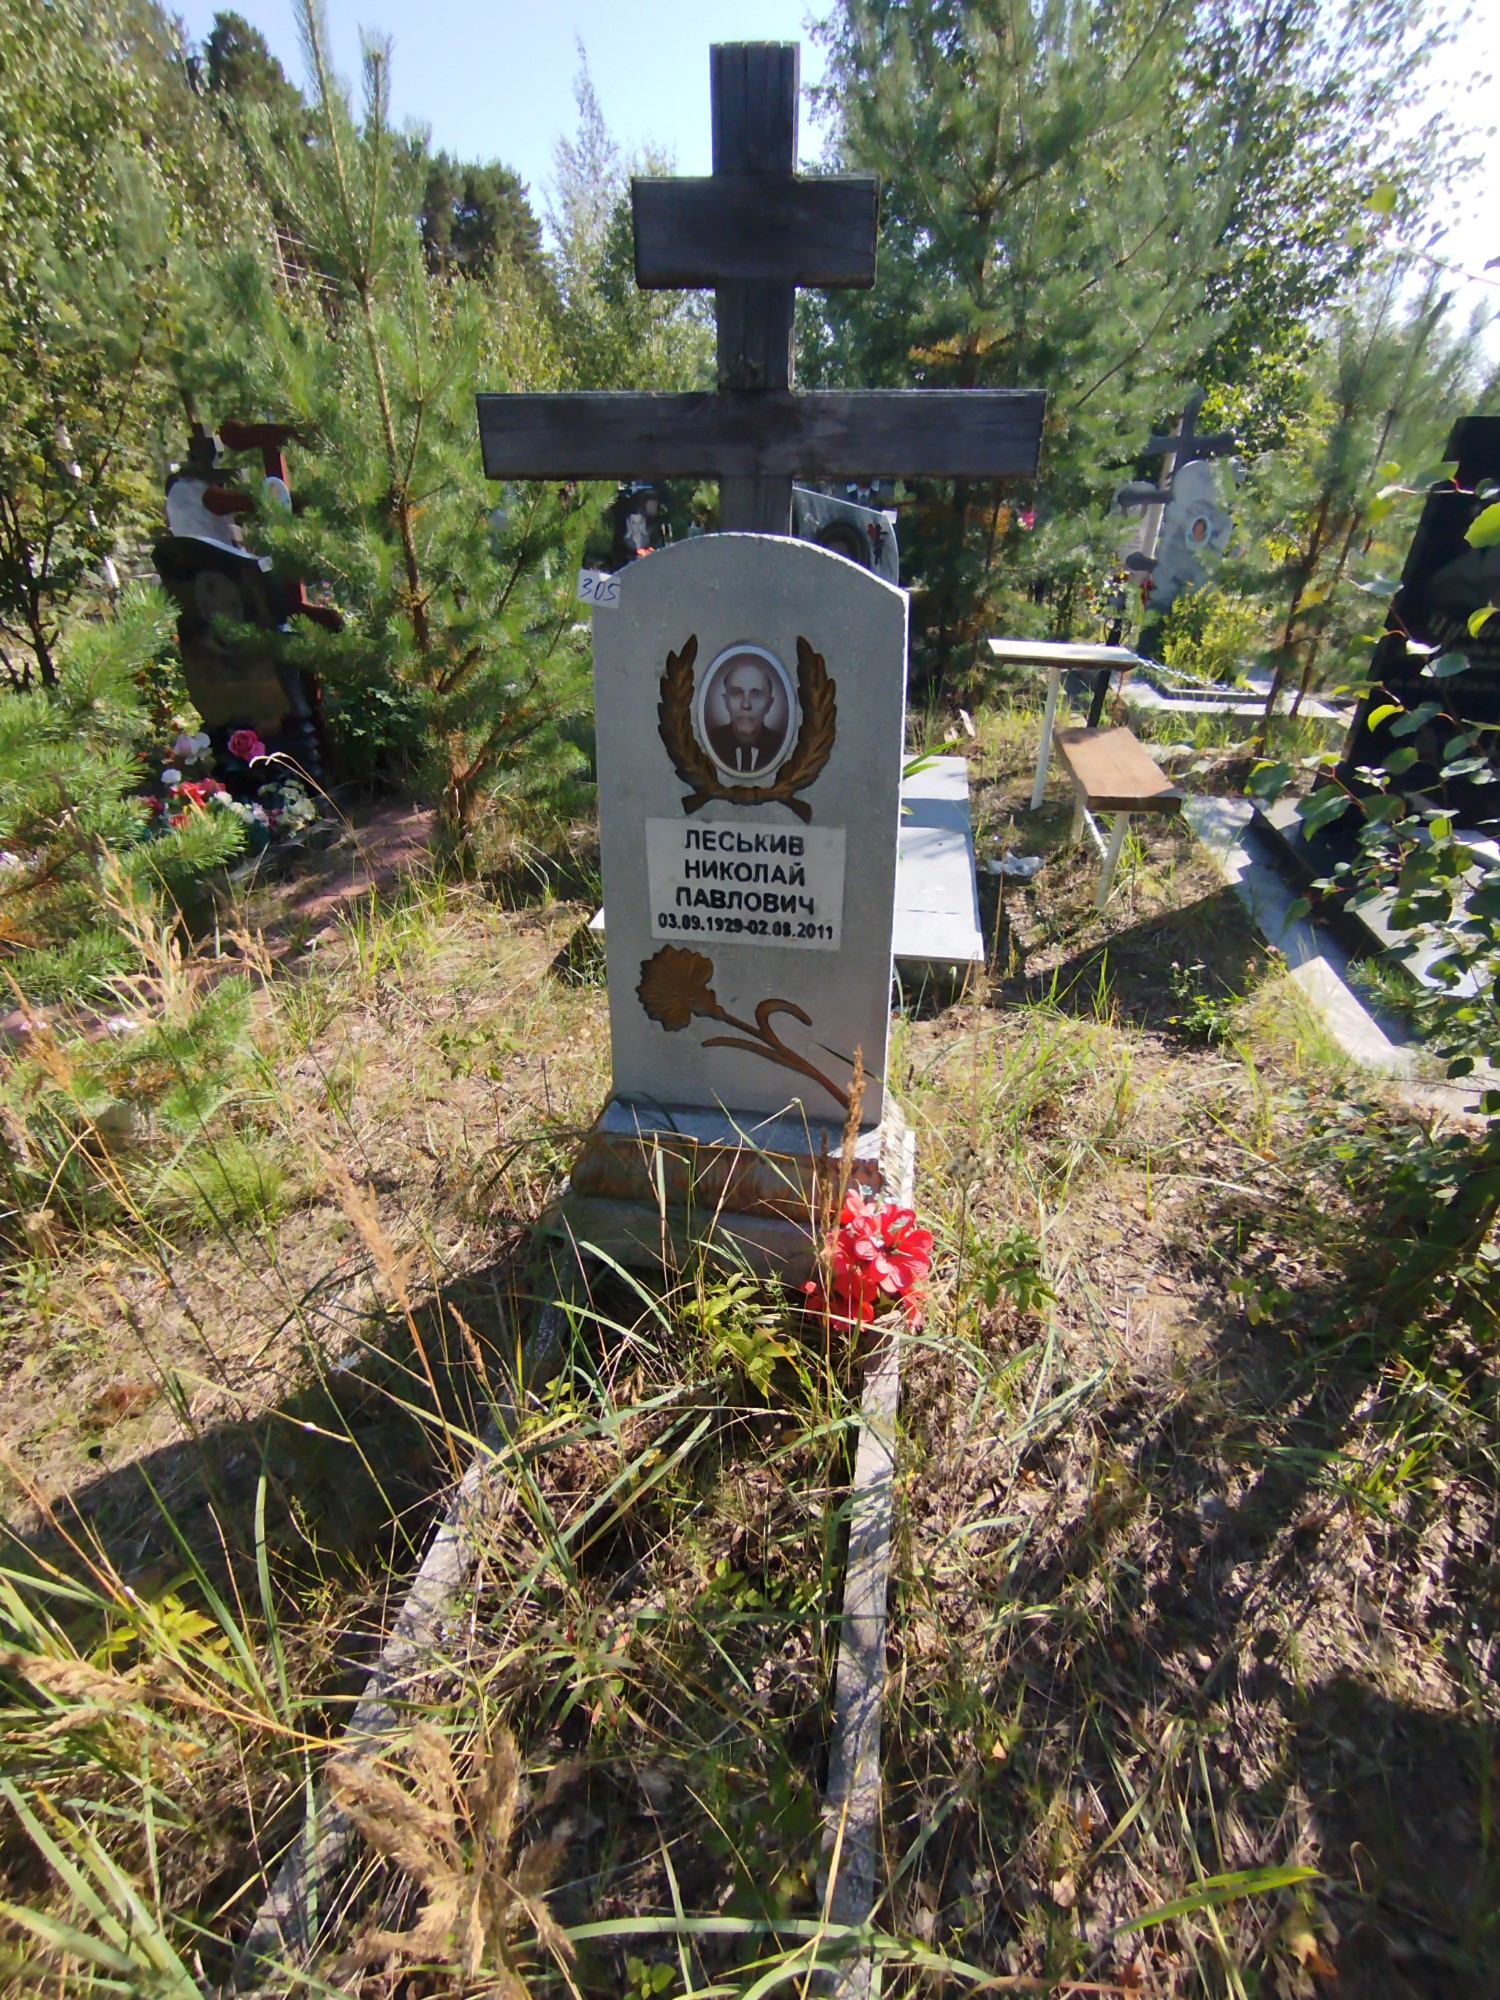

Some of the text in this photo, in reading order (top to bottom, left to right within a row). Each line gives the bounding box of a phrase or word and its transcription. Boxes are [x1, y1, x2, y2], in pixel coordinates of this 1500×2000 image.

[579, 577, 622, 602] 305
[684, 829, 805, 857] ЛЕСЬКИВ
[684, 859, 805, 887] НИКОЛАЙ
[675, 887, 815, 916] ПАВЛОВИЧ
